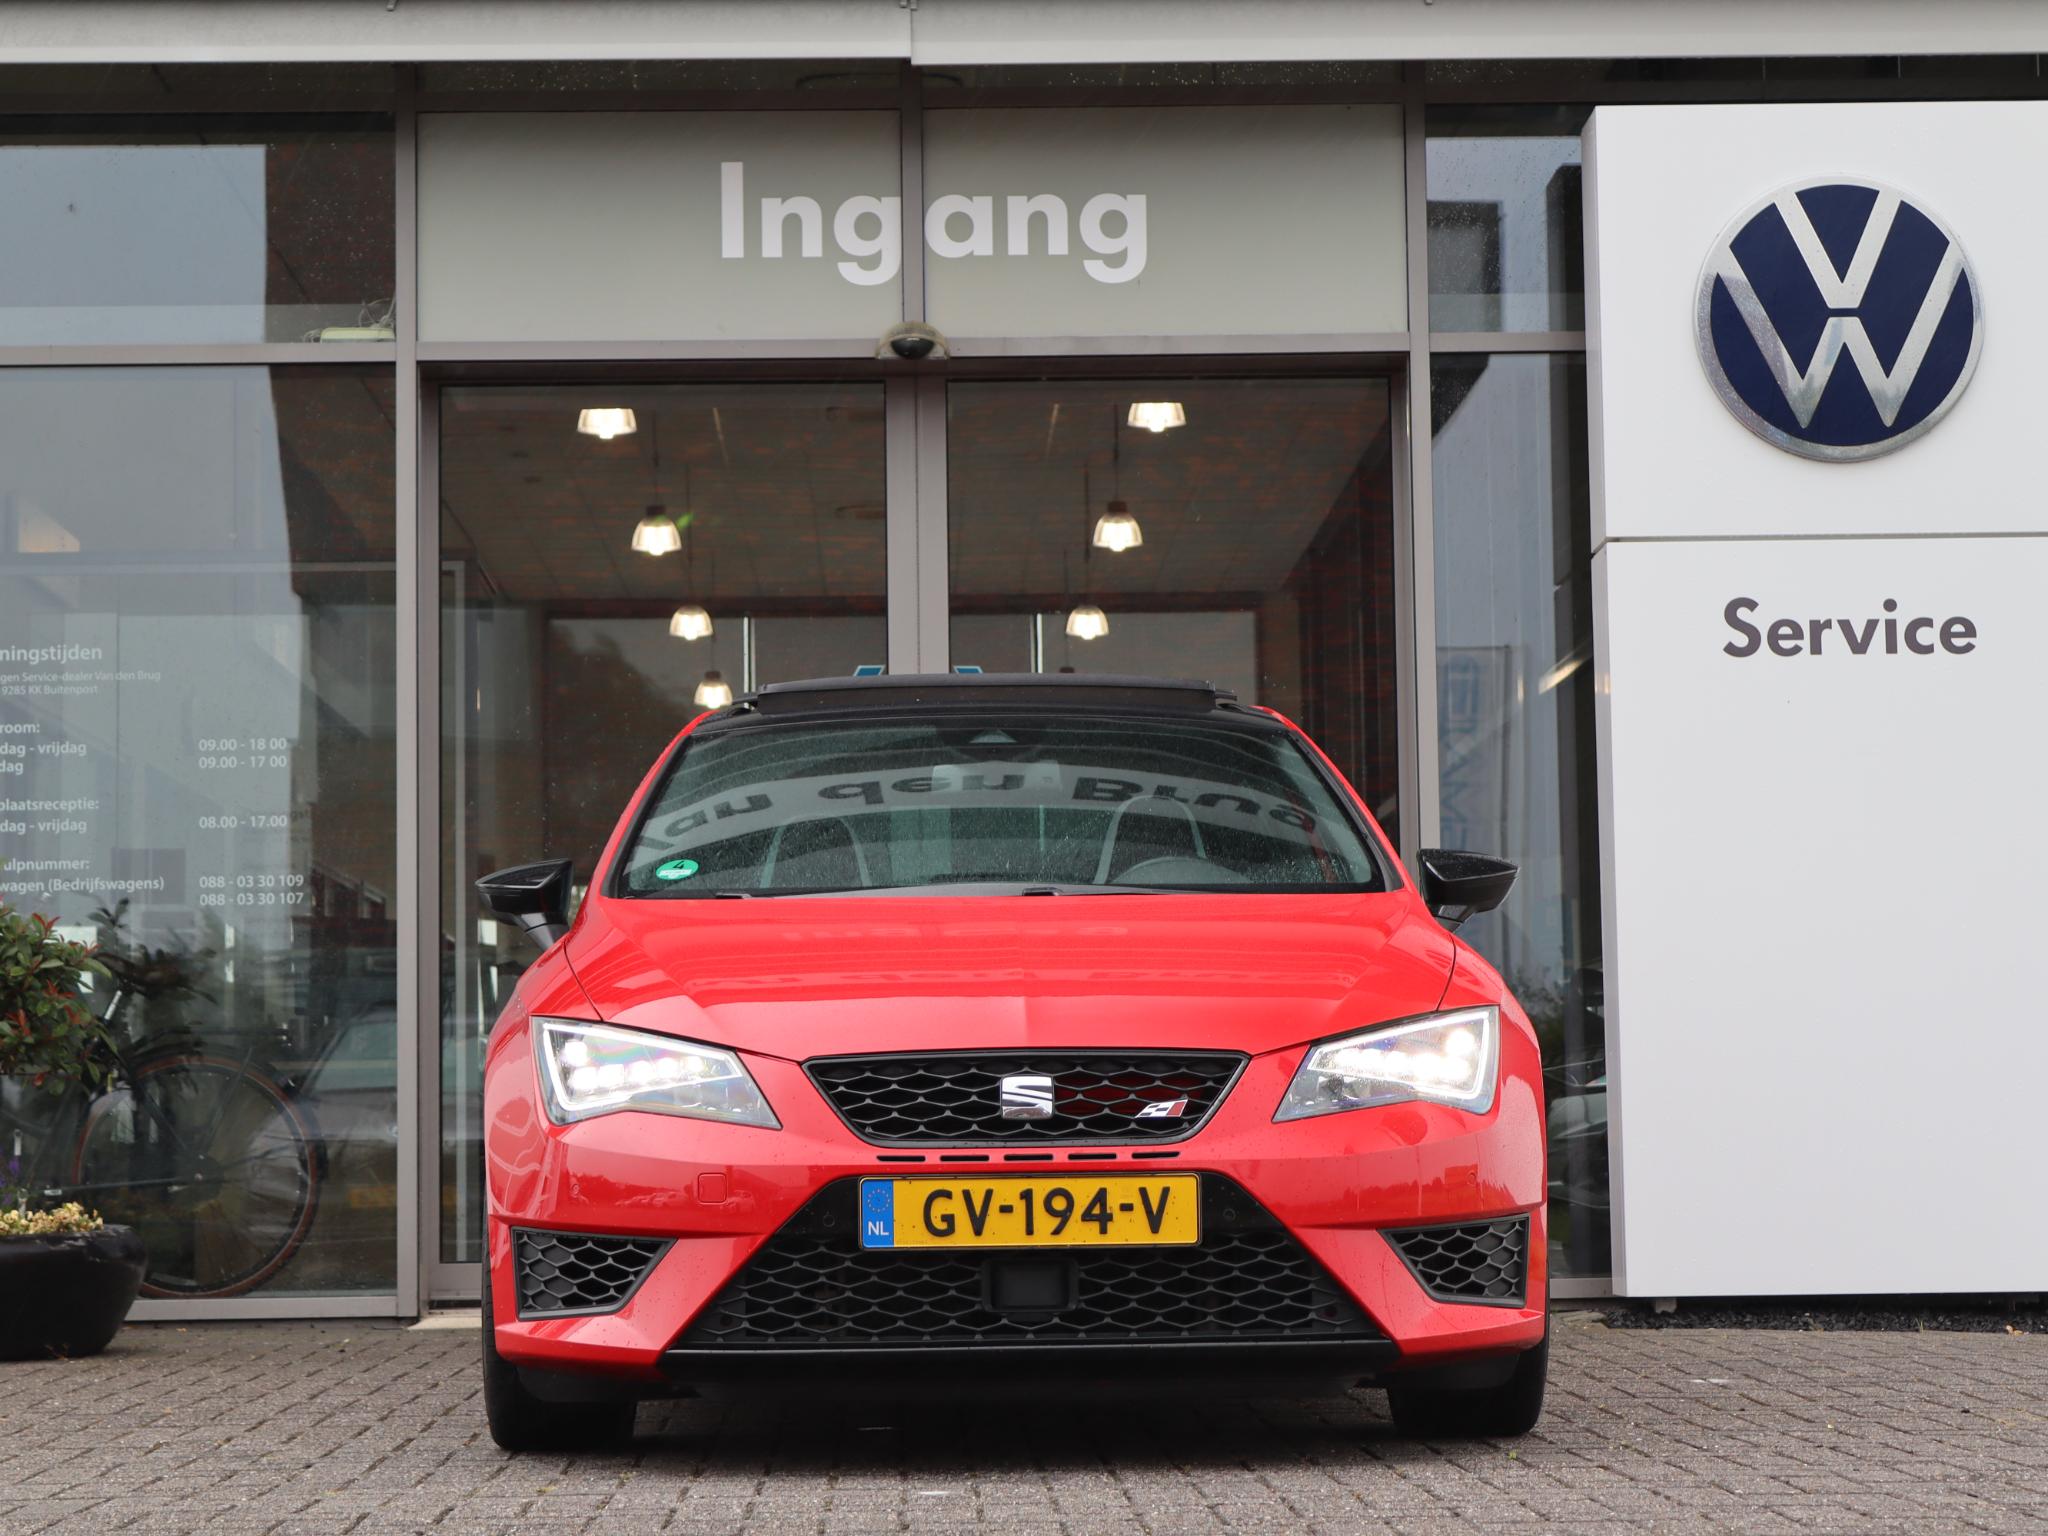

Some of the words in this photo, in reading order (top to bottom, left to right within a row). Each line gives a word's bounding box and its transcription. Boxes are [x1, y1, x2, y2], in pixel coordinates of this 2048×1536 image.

[720, 160, 1148, 286] Ingang
[1722, 596, 1977, 657] Service
[0, 644, 103, 665] ningstijden
[0, 723, 40, 734] room:
[0, 742, 26, 758] dag
[38, 741, 87, 757] vrijdag
[199, 738, 238, 751] 09.00
[199, 756, 238, 769] 09.00
[0, 819, 26, 836] dag
[38, 818, 87, 834] vrijdag
[199, 815, 238, 829] 08.00
[250, 814, 288, 828] 17.00
[48, 877, 165, 893] (Bedrijfswagens)
[199, 875, 226, 888] 088
[237, 875, 255, 888] 03
[257, 874, 276, 887] 30
[278, 873, 305, 887] 109
[199, 893, 226, 906] 088
[237, 893, 255, 905] 03
[257, 892, 276, 905] 30
[278, 891, 305, 905] 107
[923, 1185, 1170, 1238] GV-194-V
[867, 1220, 890, 1236] NL
